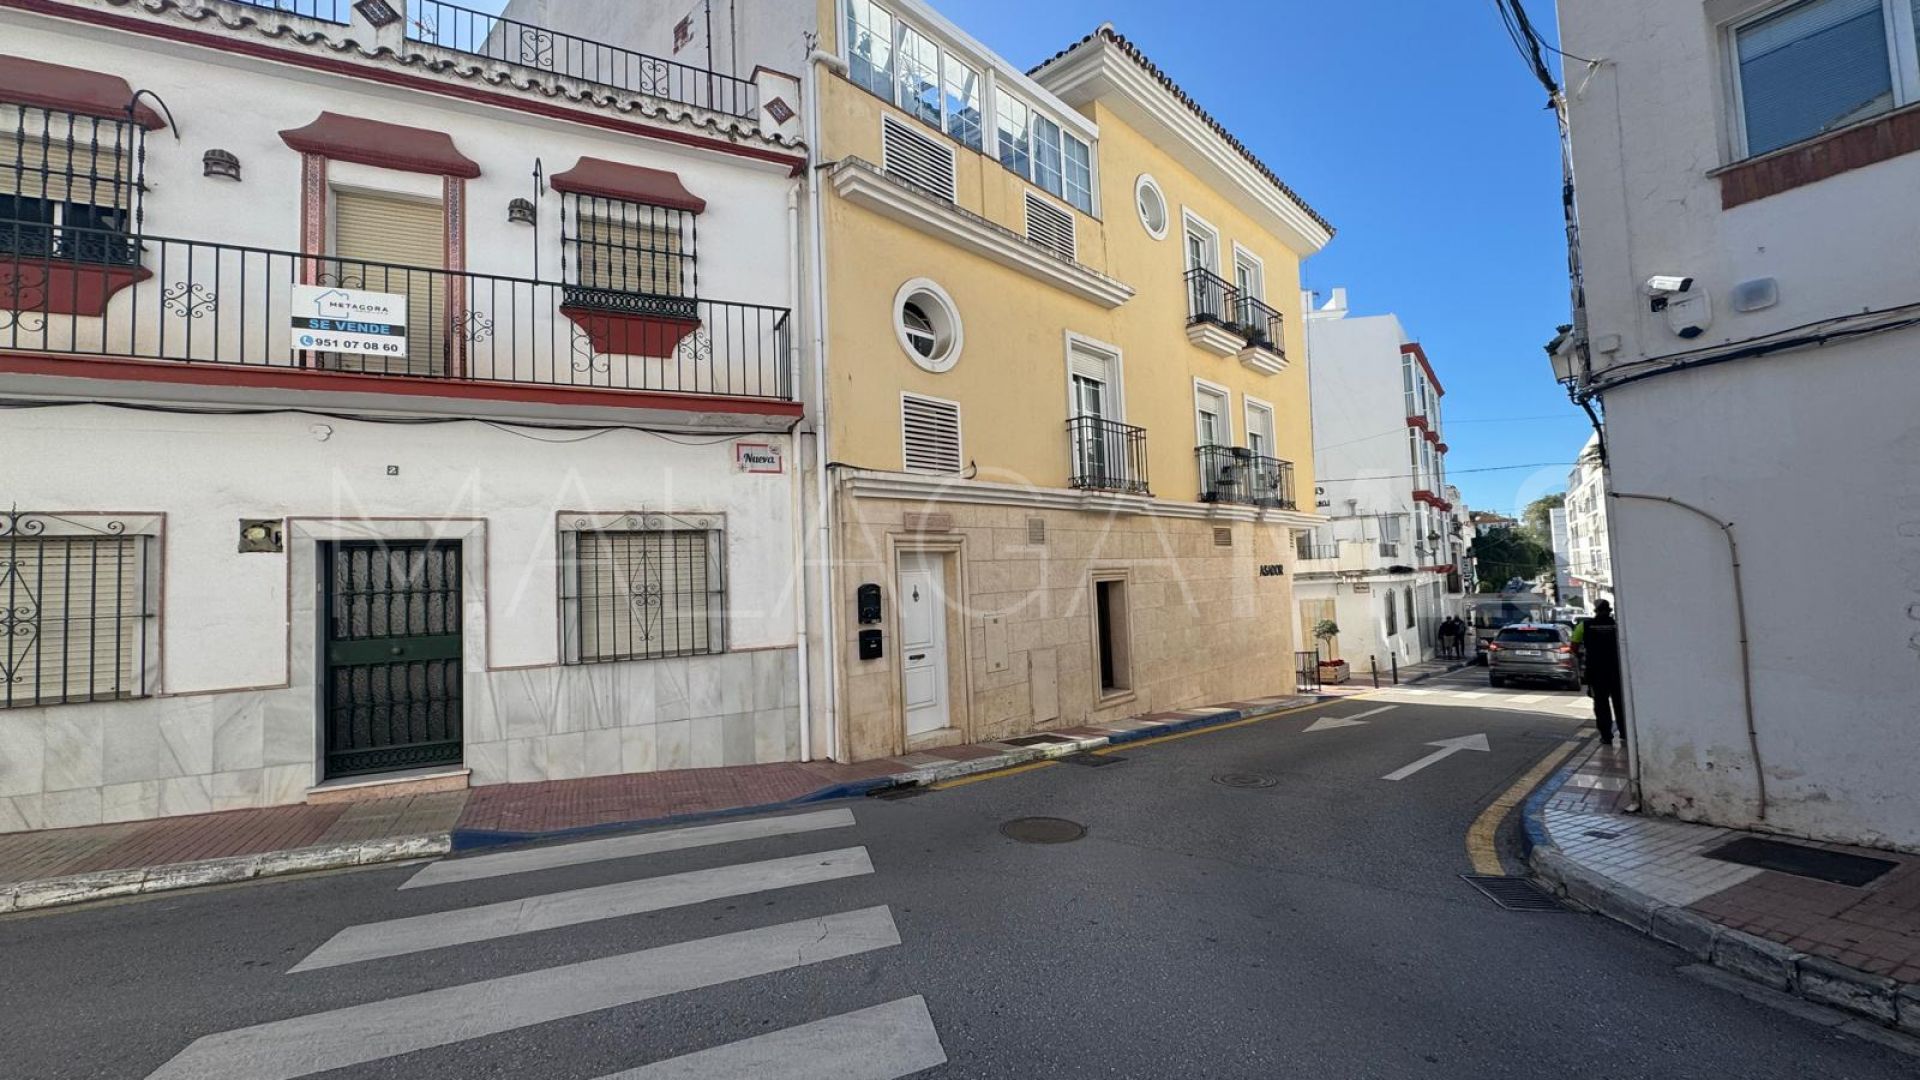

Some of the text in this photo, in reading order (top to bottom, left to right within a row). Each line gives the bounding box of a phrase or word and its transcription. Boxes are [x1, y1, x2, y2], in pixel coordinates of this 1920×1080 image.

[329, 301, 389, 313] METAGORA
[309, 318, 391, 335] SE VENDE
[315, 338, 398, 352] 951 07 08 60
[743, 452, 776, 464] Nueva
